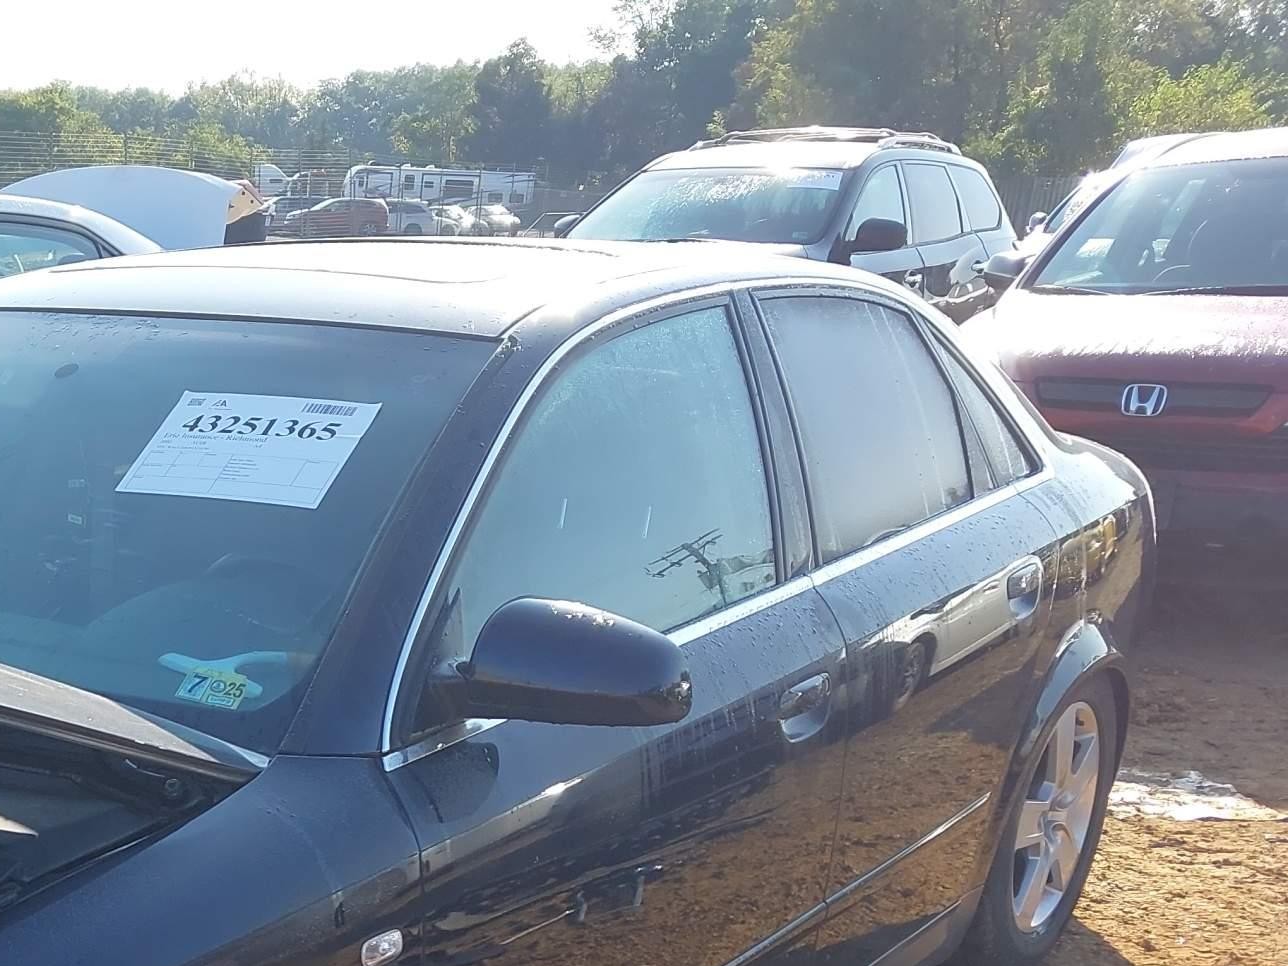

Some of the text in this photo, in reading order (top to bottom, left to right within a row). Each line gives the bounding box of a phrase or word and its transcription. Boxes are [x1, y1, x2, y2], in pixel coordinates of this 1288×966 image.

[181, 413, 342, 441] 43251365
[187, 673, 247, 698] 7 25
